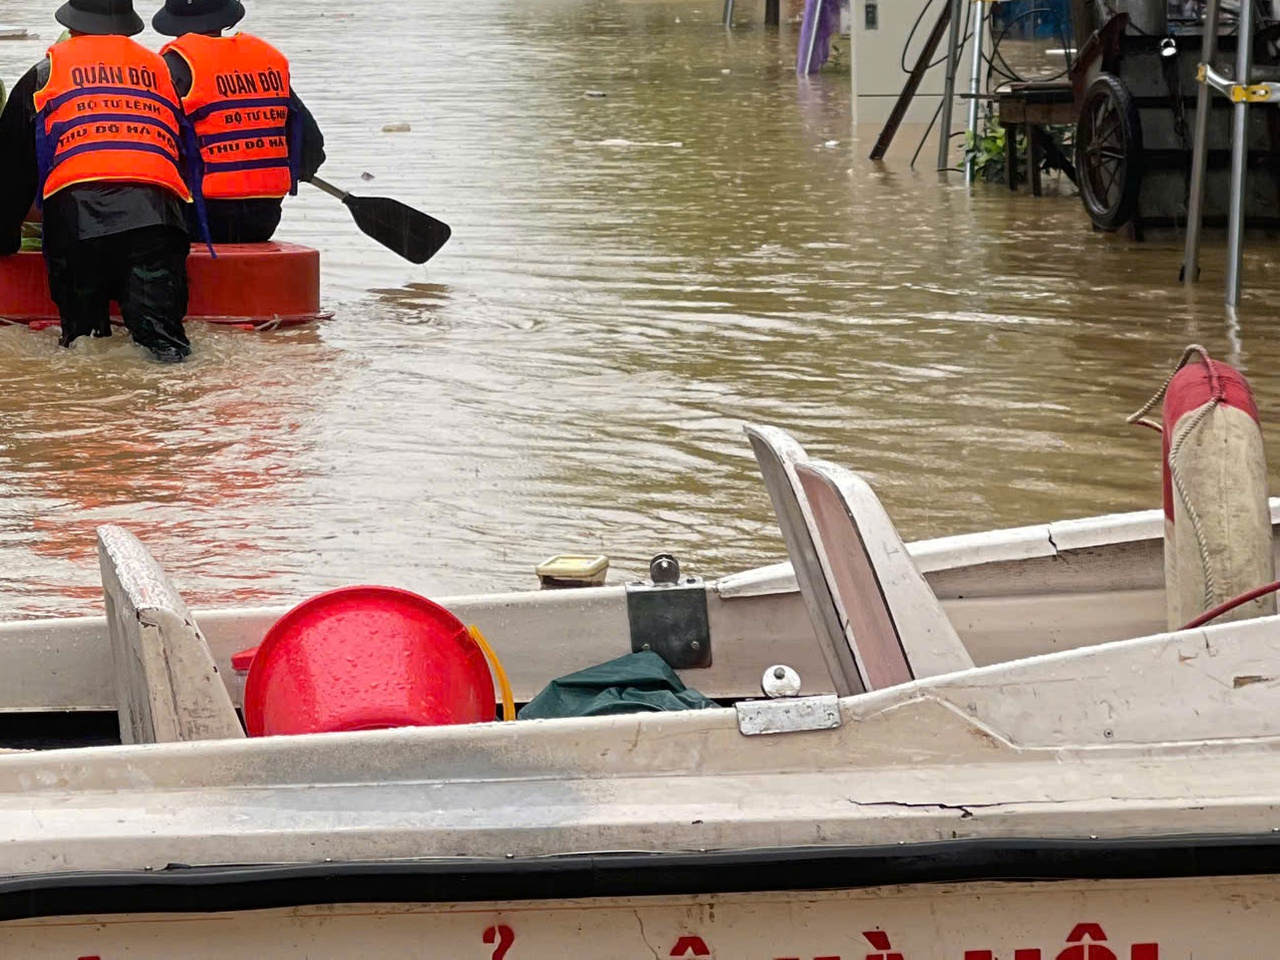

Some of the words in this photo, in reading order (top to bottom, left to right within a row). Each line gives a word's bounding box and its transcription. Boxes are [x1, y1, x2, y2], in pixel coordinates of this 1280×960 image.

[71, 63, 124, 88] QUÂN
[128, 66, 158, 91] ĐỘI
[216, 69, 258, 97] QUÂN
[258, 67, 284, 97] ĐỘI
[224, 111, 242, 125] BỘ
[246, 111, 261, 122] TƯ
